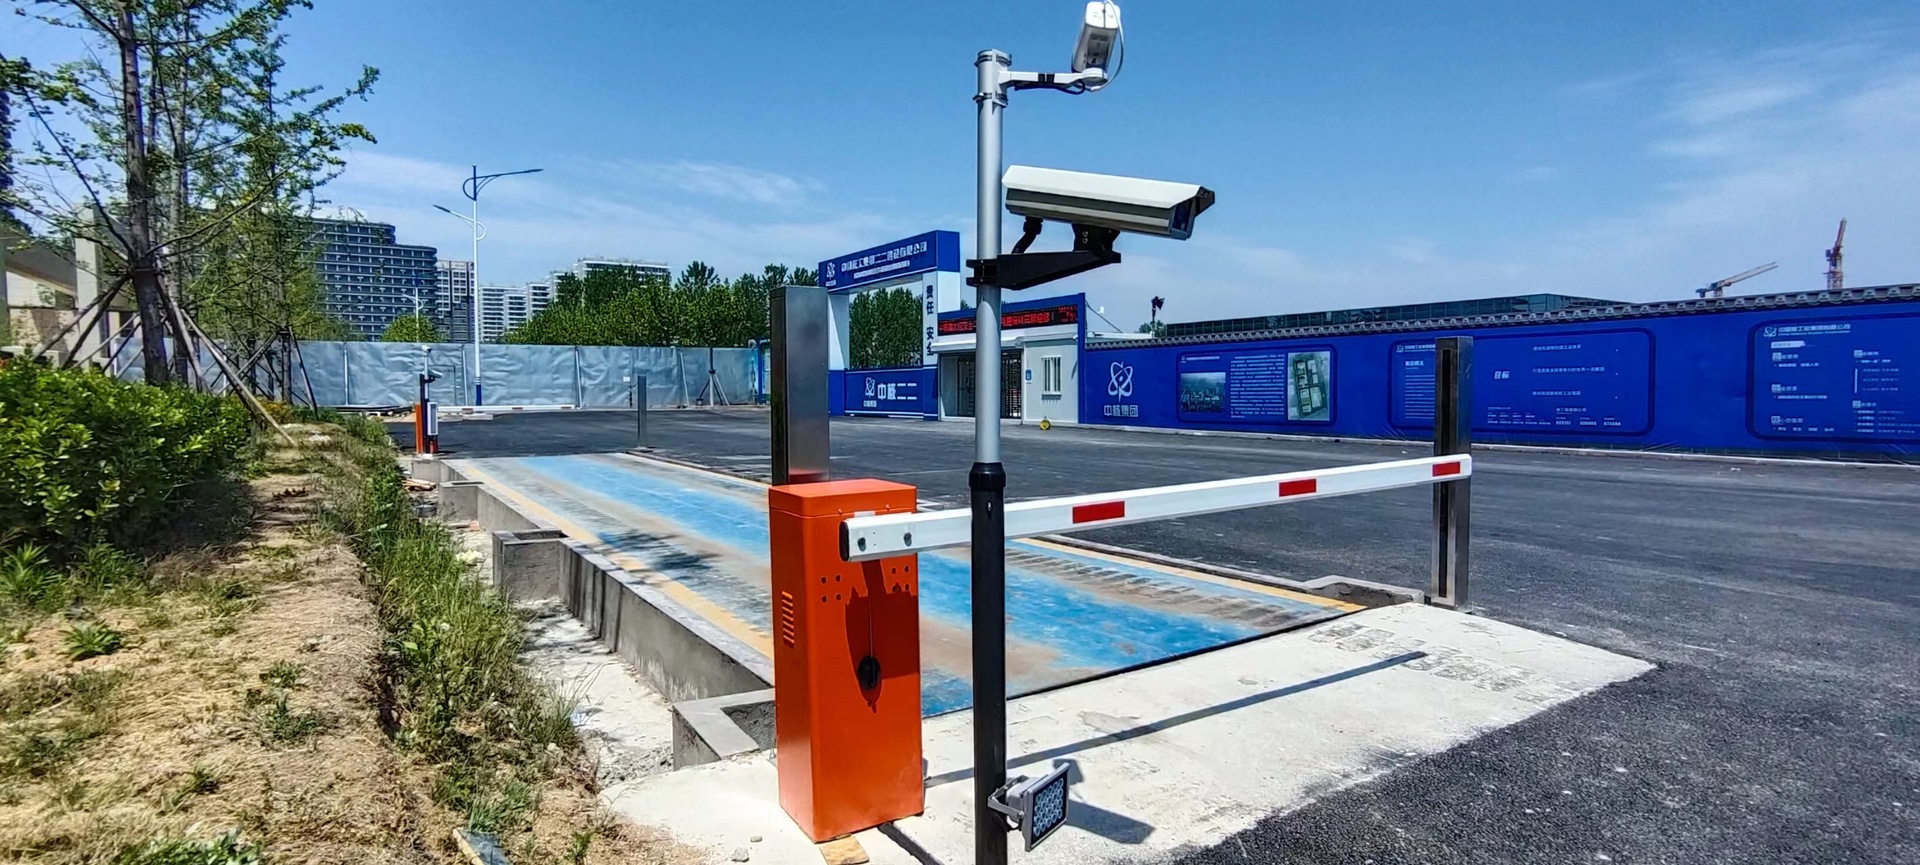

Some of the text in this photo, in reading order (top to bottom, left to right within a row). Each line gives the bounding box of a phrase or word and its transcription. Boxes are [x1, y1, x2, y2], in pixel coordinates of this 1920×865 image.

[877, 383, 917, 400] 中核二二
[1103, 404, 1139, 417] 中核集团
